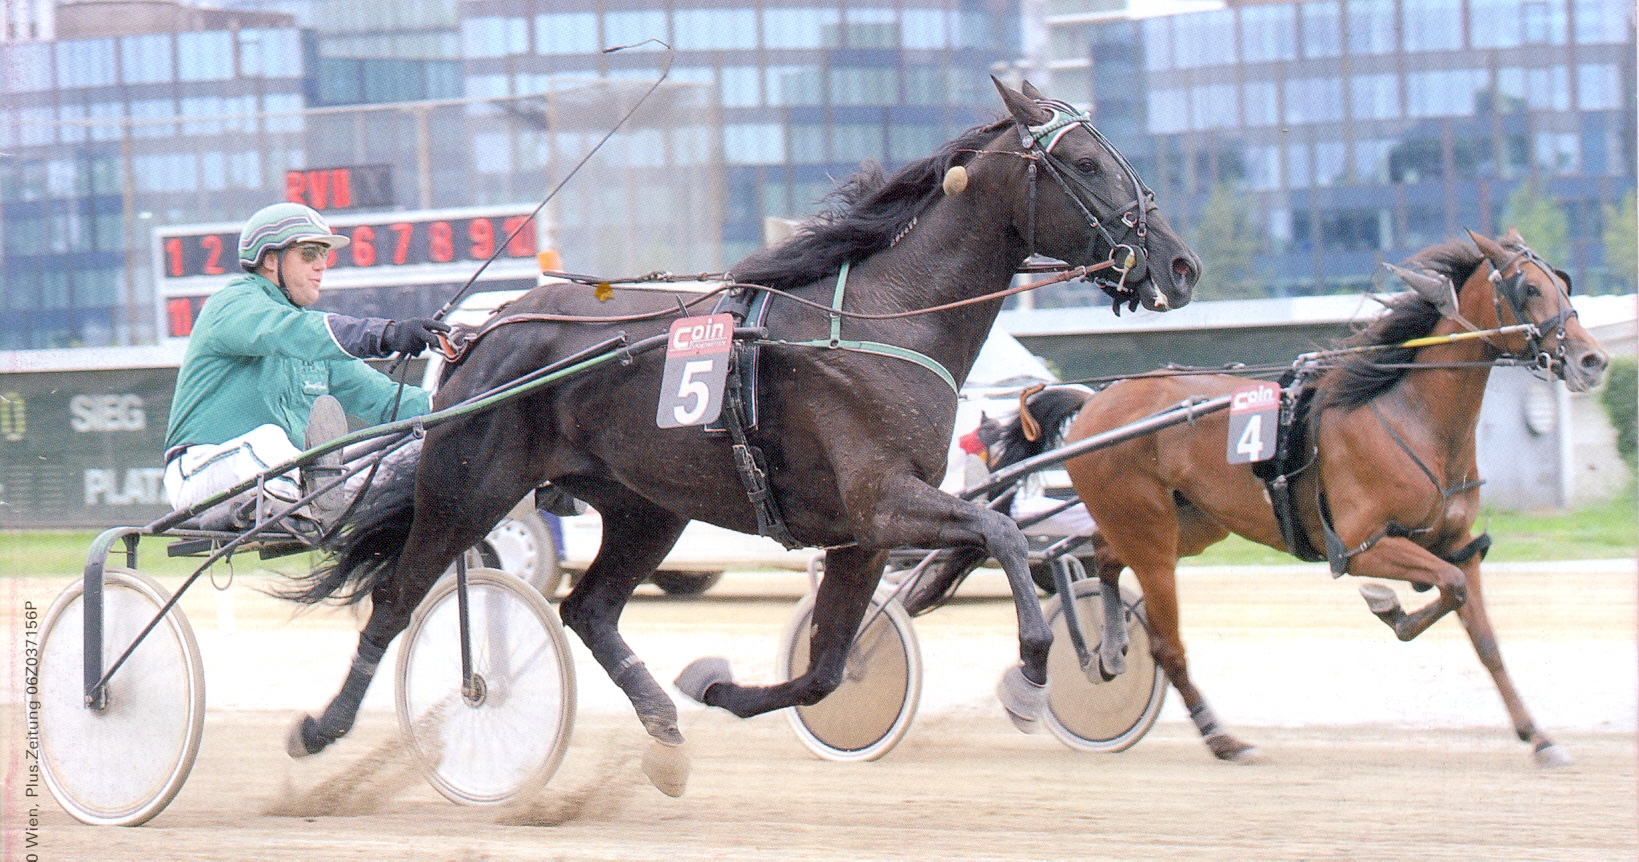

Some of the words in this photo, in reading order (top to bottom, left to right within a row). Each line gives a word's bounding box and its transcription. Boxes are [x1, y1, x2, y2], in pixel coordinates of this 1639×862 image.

[165, 238, 183, 276] 1
[202, 234, 225, 275] 2
[352, 225, 376, 267] 6
[390, 222, 413, 264] 7
[429, 221, 453, 262] 8
[468, 218, 494, 259] 9
[673, 360, 714, 425] 5
[1236, 414, 1264, 462] 4
